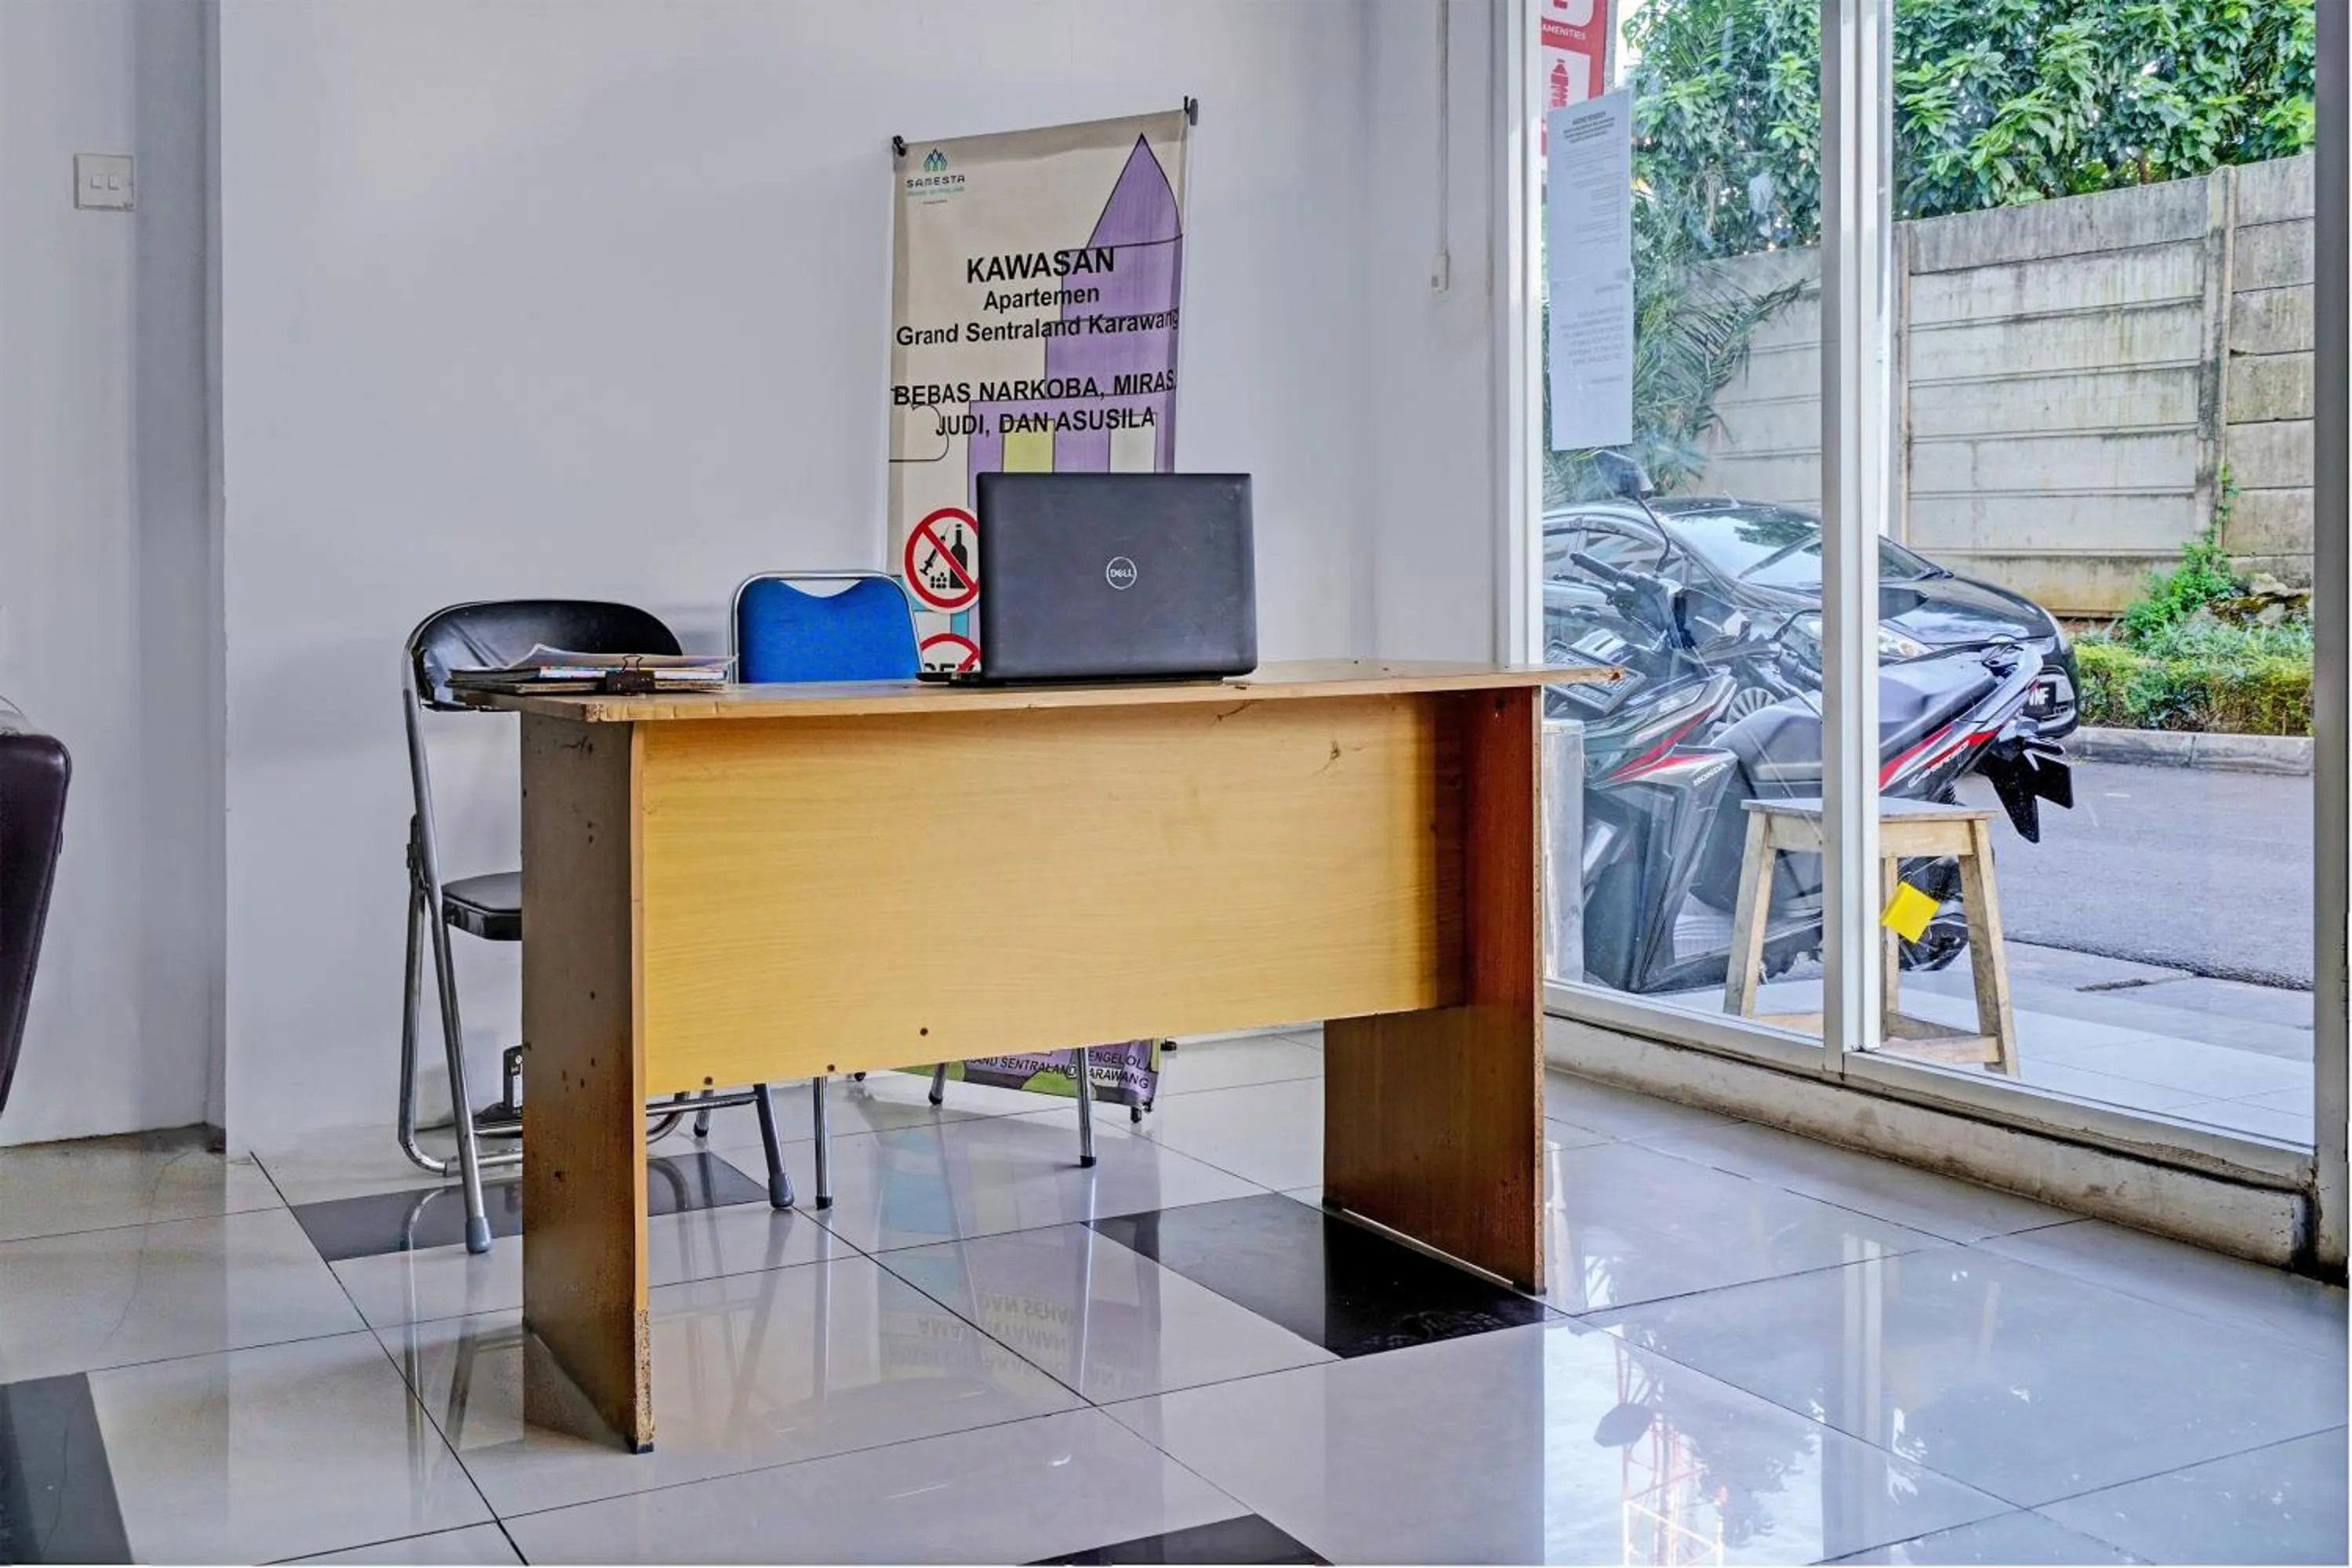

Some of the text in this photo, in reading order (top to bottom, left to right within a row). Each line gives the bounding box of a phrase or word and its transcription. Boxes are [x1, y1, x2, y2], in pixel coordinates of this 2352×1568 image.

[967, 246, 1115, 284] KAWASAN
[983, 288, 1100, 314] Apartemen
[896, 308, 1179, 346] Grand Sentraland Karawang
[894, 382, 971, 406] BEBAS
[979, 376, 1105, 401] NARKOBA,
[935, 406, 1155, 438] JUDI, DAN ASUSILA
[1110, 568, 1134, 578] DELL
[1000, 1054, 1076, 1080] SENTRALAND
[1088, 1067, 1149, 1090] ARAWANG
[1088, 1050, 1150, 1072] ENGELOL
